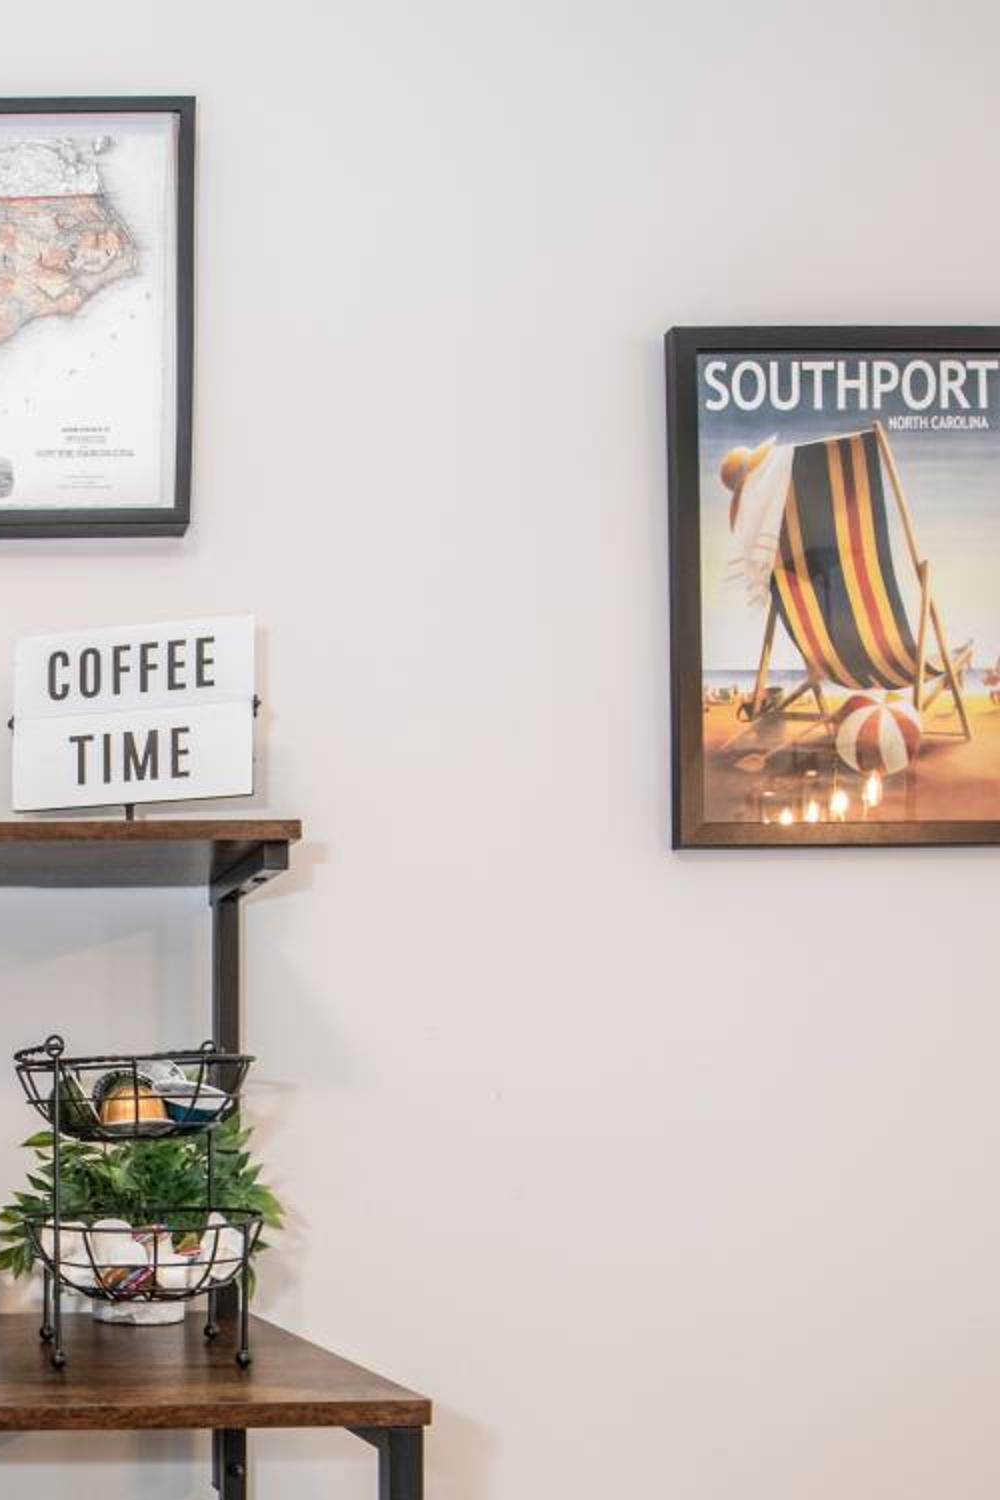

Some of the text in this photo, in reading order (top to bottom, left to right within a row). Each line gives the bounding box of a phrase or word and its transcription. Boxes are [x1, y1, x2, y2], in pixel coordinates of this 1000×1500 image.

[703, 359, 999, 411] SOUTHPORT
[888, 415, 989, 430] NORTH CAROLINA
[48, 636, 215, 701] COFFEE
[69, 726, 190, 786] TIME
